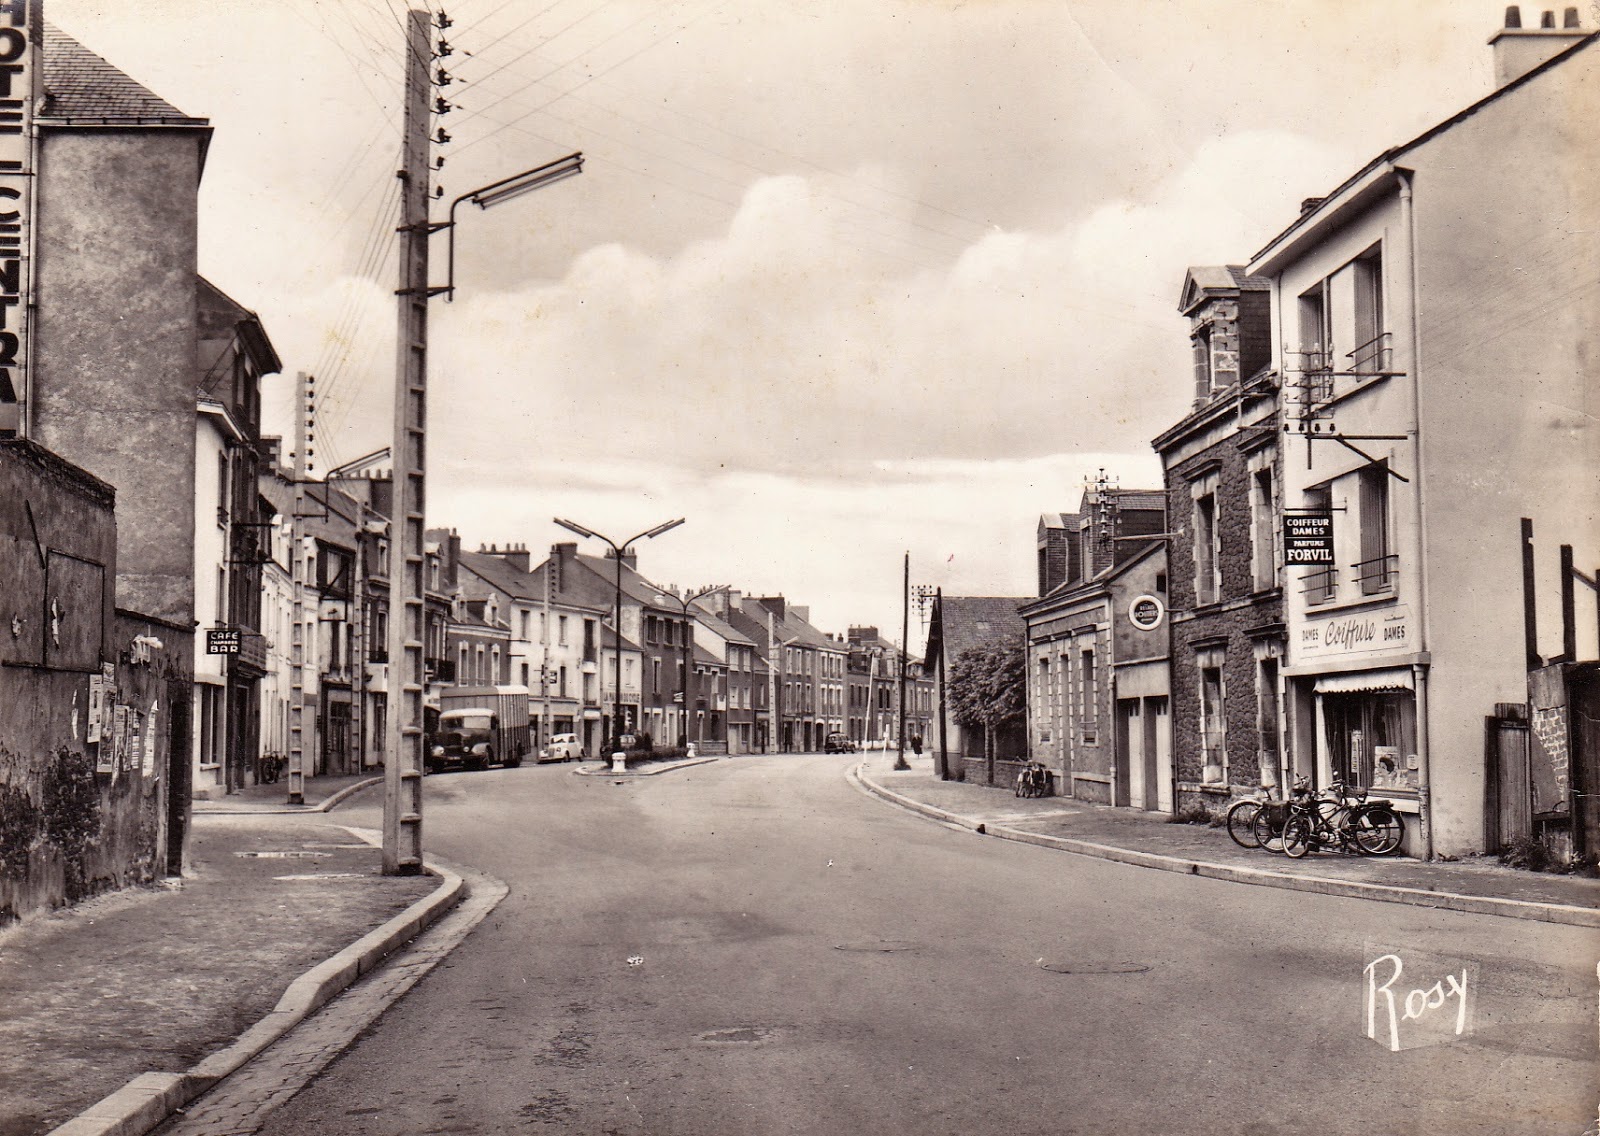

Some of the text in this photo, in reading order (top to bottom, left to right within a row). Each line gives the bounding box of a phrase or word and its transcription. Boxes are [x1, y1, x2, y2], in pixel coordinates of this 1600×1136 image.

[1286, 518, 1329, 526] COIFFEUR
[1292, 527, 1325, 535] DAMES
[1287, 548, 1332, 561] FORVIL
[1302, 619, 1405, 650] DAMES Coiffure DAMES
[210, 645, 239, 653] BAR
